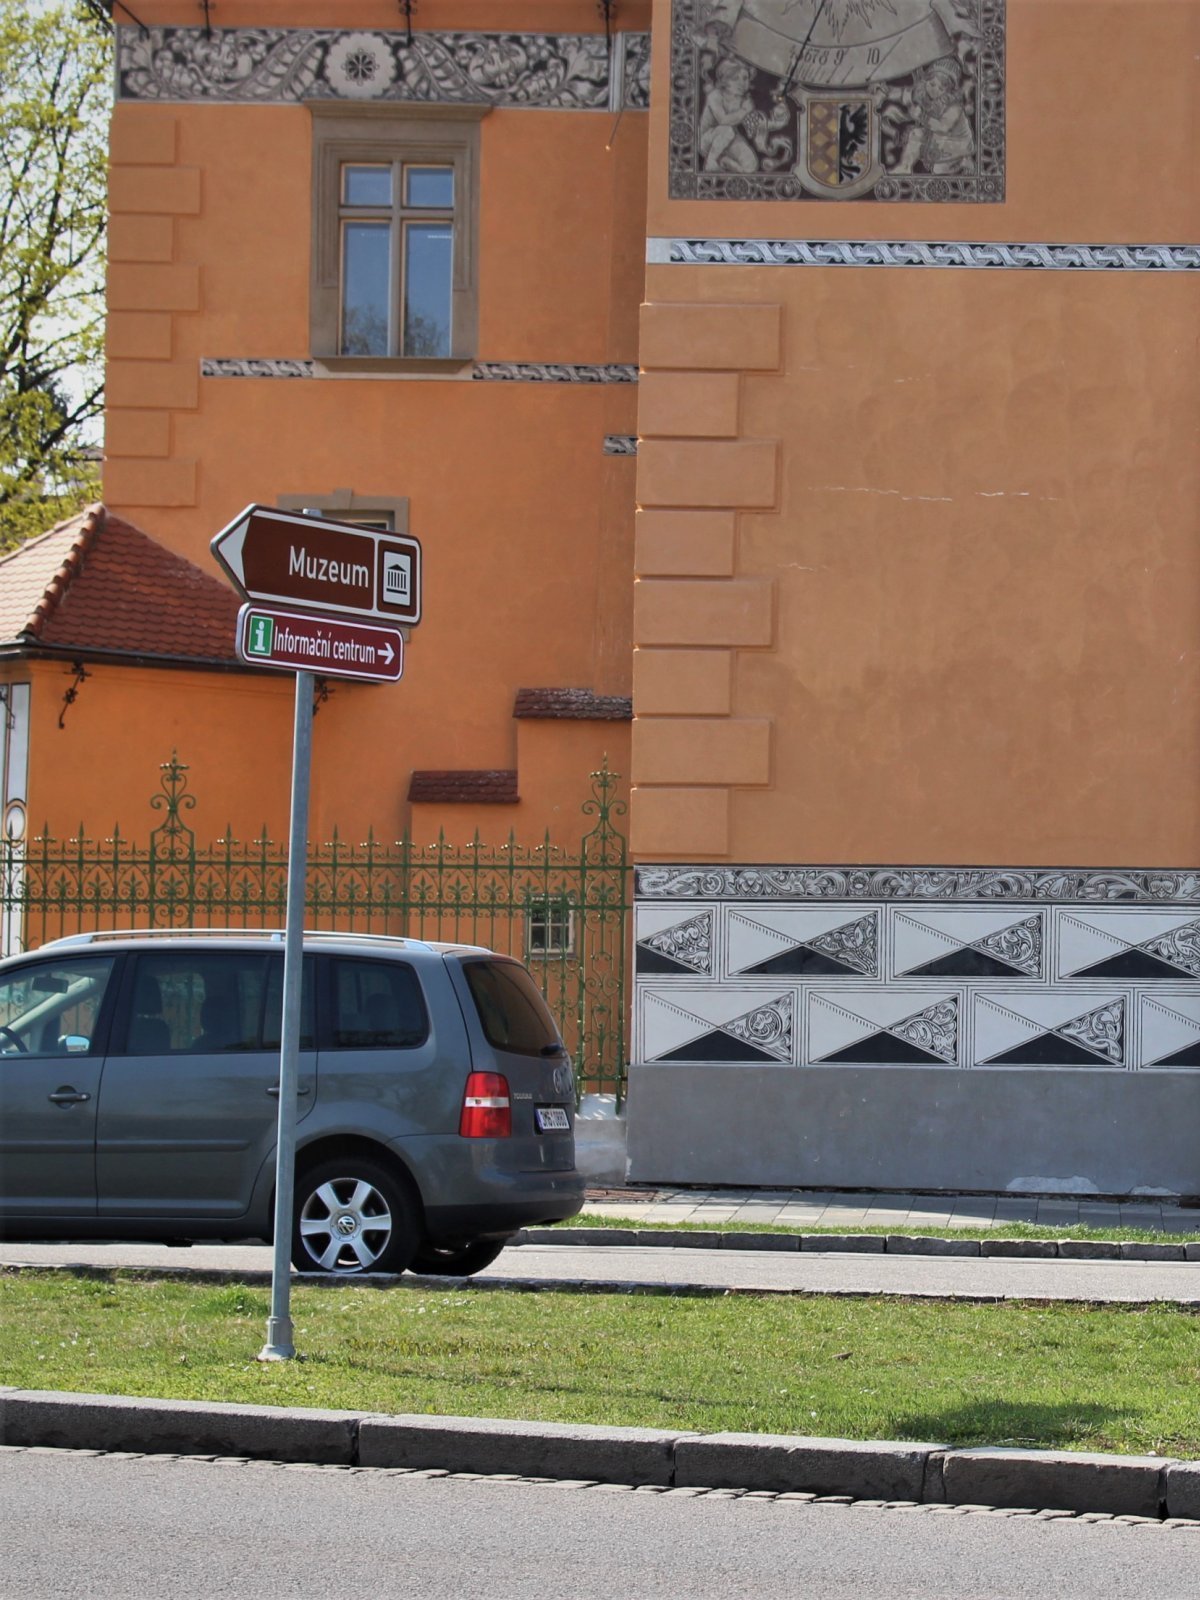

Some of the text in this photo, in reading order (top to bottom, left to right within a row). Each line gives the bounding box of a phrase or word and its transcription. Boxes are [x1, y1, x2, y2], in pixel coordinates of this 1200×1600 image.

[866, 47, 881, 65] 10
[288, 545, 369, 589] Muzeum
[273, 626, 332, 659] Informační
[333, 636, 376, 664] centrum
